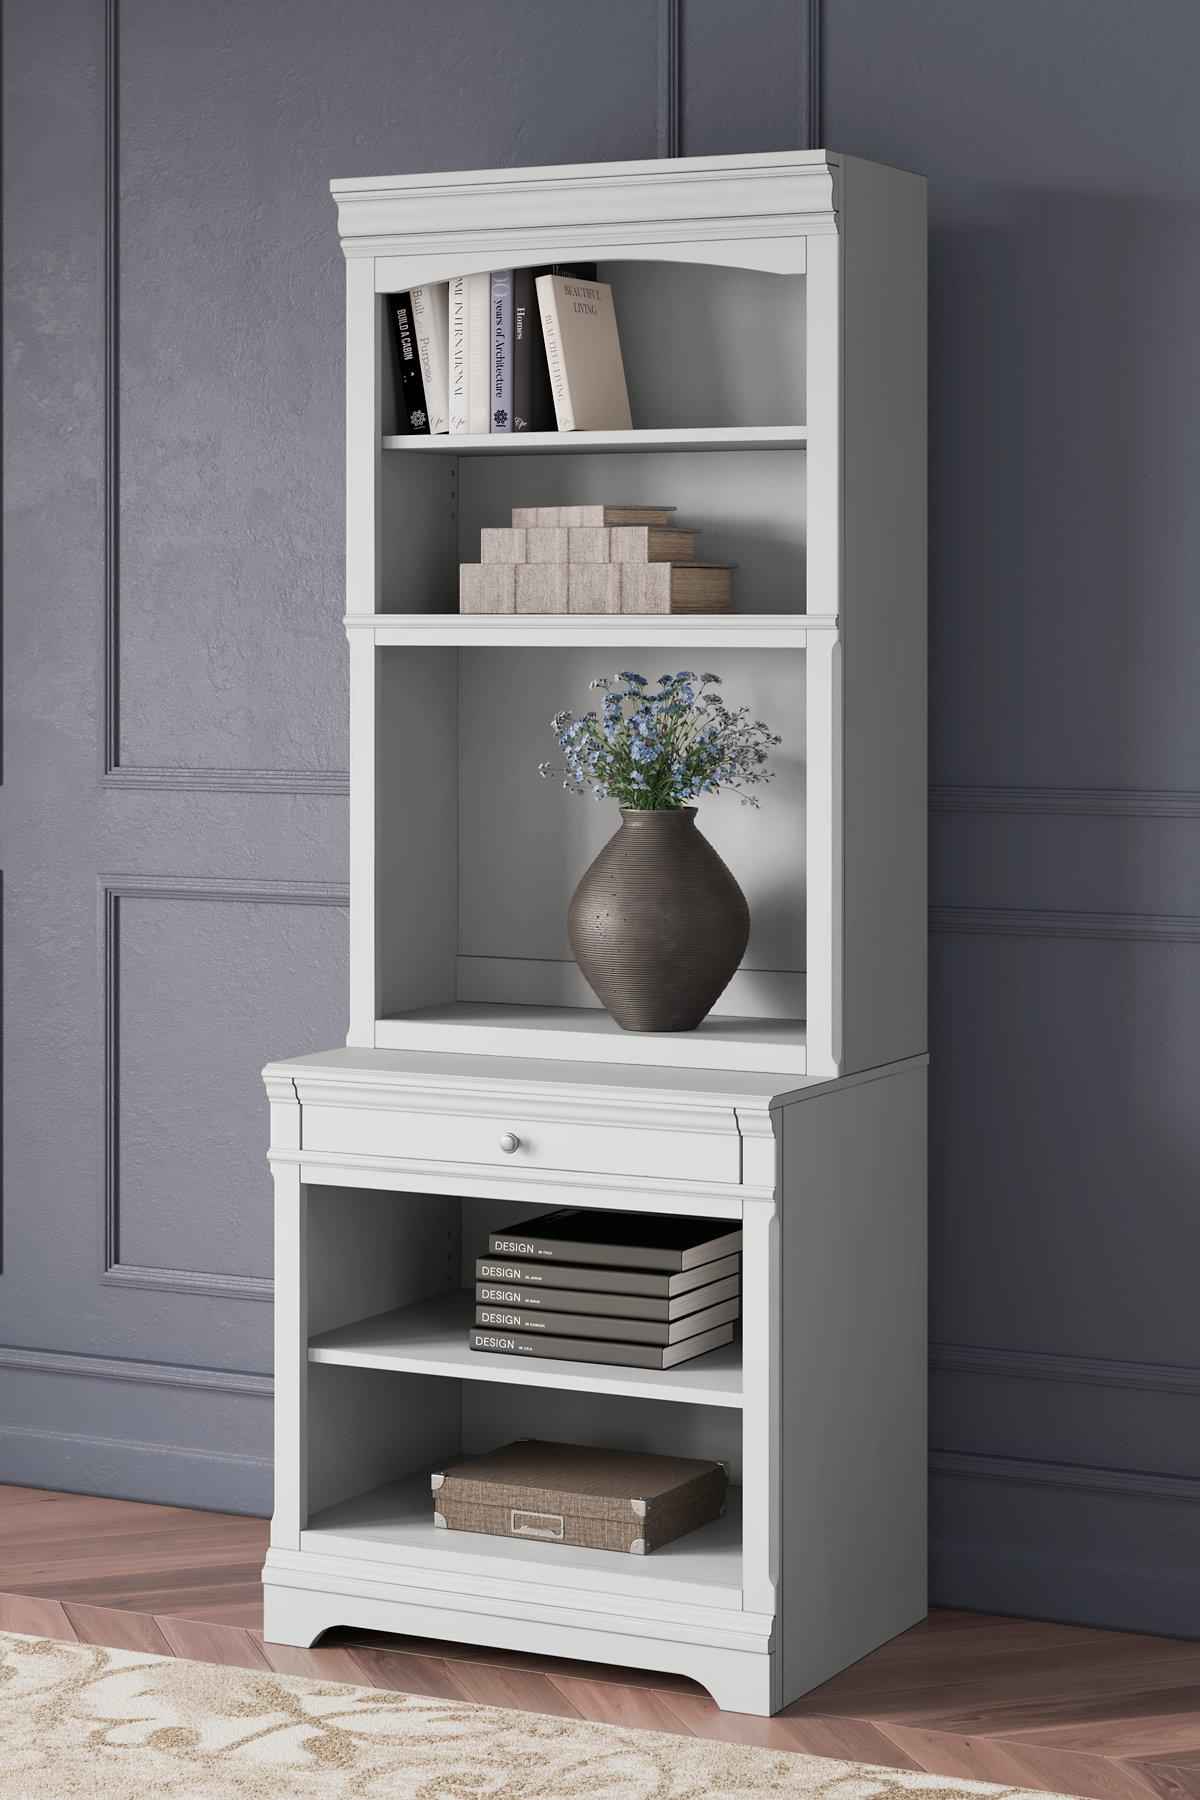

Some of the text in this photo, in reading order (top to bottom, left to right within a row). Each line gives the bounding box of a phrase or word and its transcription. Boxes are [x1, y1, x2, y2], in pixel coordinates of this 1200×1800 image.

[412, 287, 424, 315] Built
[564, 284, 600, 301] BEAUTIFUL
[495, 298, 503, 326] years
[573, 302, 598, 316] LIVING
[397, 309, 409, 331] BUILD
[516, 308, 526, 340] Homes
[496, 327, 506, 338] of
[401, 338, 414, 360] CABIN
[454, 302, 464, 400] INTERNATIONAL
[495, 340, 506, 399] Architecture
[495, 1240, 534, 1254] DESIGN
[481, 1265, 521, 1279] DESIGN
[481, 1289, 521, 1303] DESIGN
[481, 1312, 521, 1326] DESIGN
[475, 1335, 515, 1350] DESIGN
